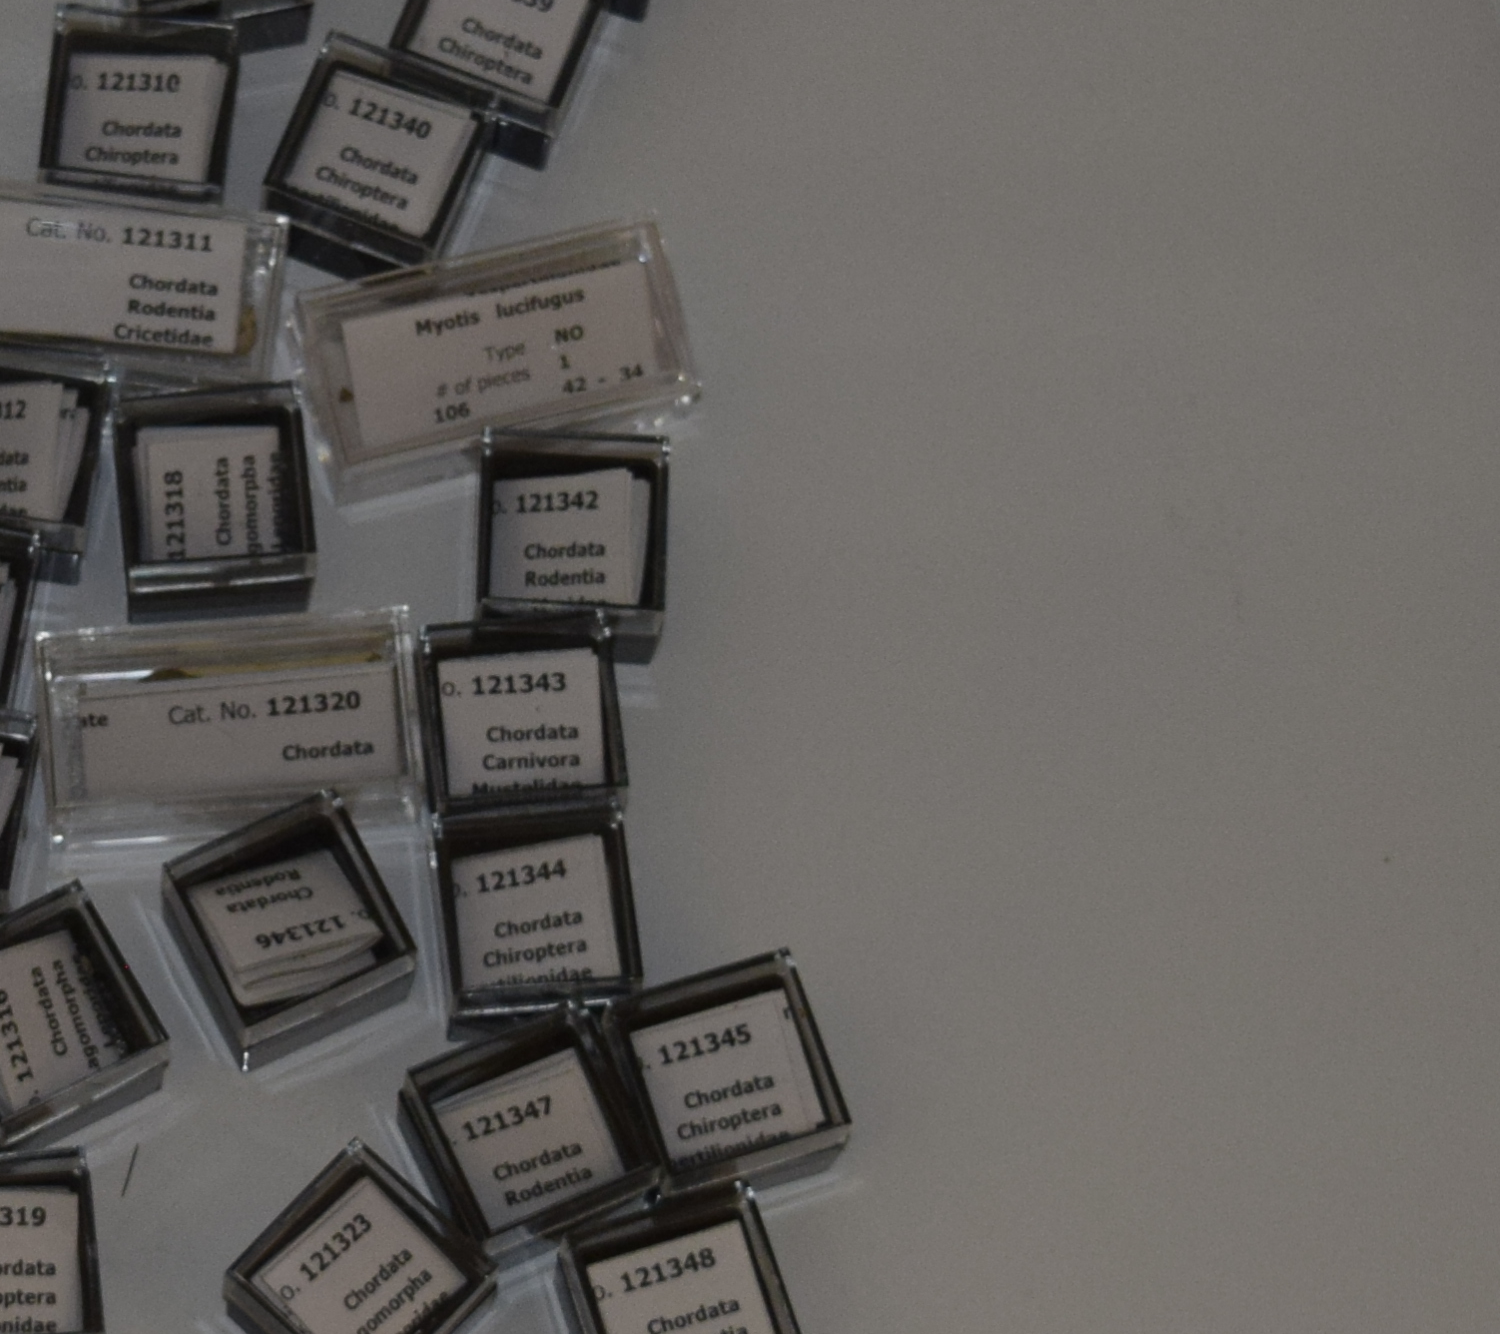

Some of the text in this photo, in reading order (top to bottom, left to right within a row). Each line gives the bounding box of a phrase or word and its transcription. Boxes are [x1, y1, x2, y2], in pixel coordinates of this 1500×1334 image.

[97, 72, 180, 92] 121310
[349, 98, 431, 139] 121340
[123, 227, 212, 252] 121311
[129, 274, 219, 296] Chordata
[127, 299, 216, 322] Rodentia
[415, 289, 585, 336] Myotis lucifugus
[114, 323, 213, 346] Cricetidae
[516, 490, 599, 514] 121342
[472, 672, 567, 696] 121343
[267, 691, 361, 717] 121320
[486, 724, 579, 743] Chordata
[482, 753, 581, 771] Carnivora
[476, 859, 567, 894] 121344
[658, 1023, 751, 1066] 121345
[462, 1095, 551, 1142] 121347
[300, 1214, 372, 1282] 121323
[620, 1248, 716, 1293] 121348
